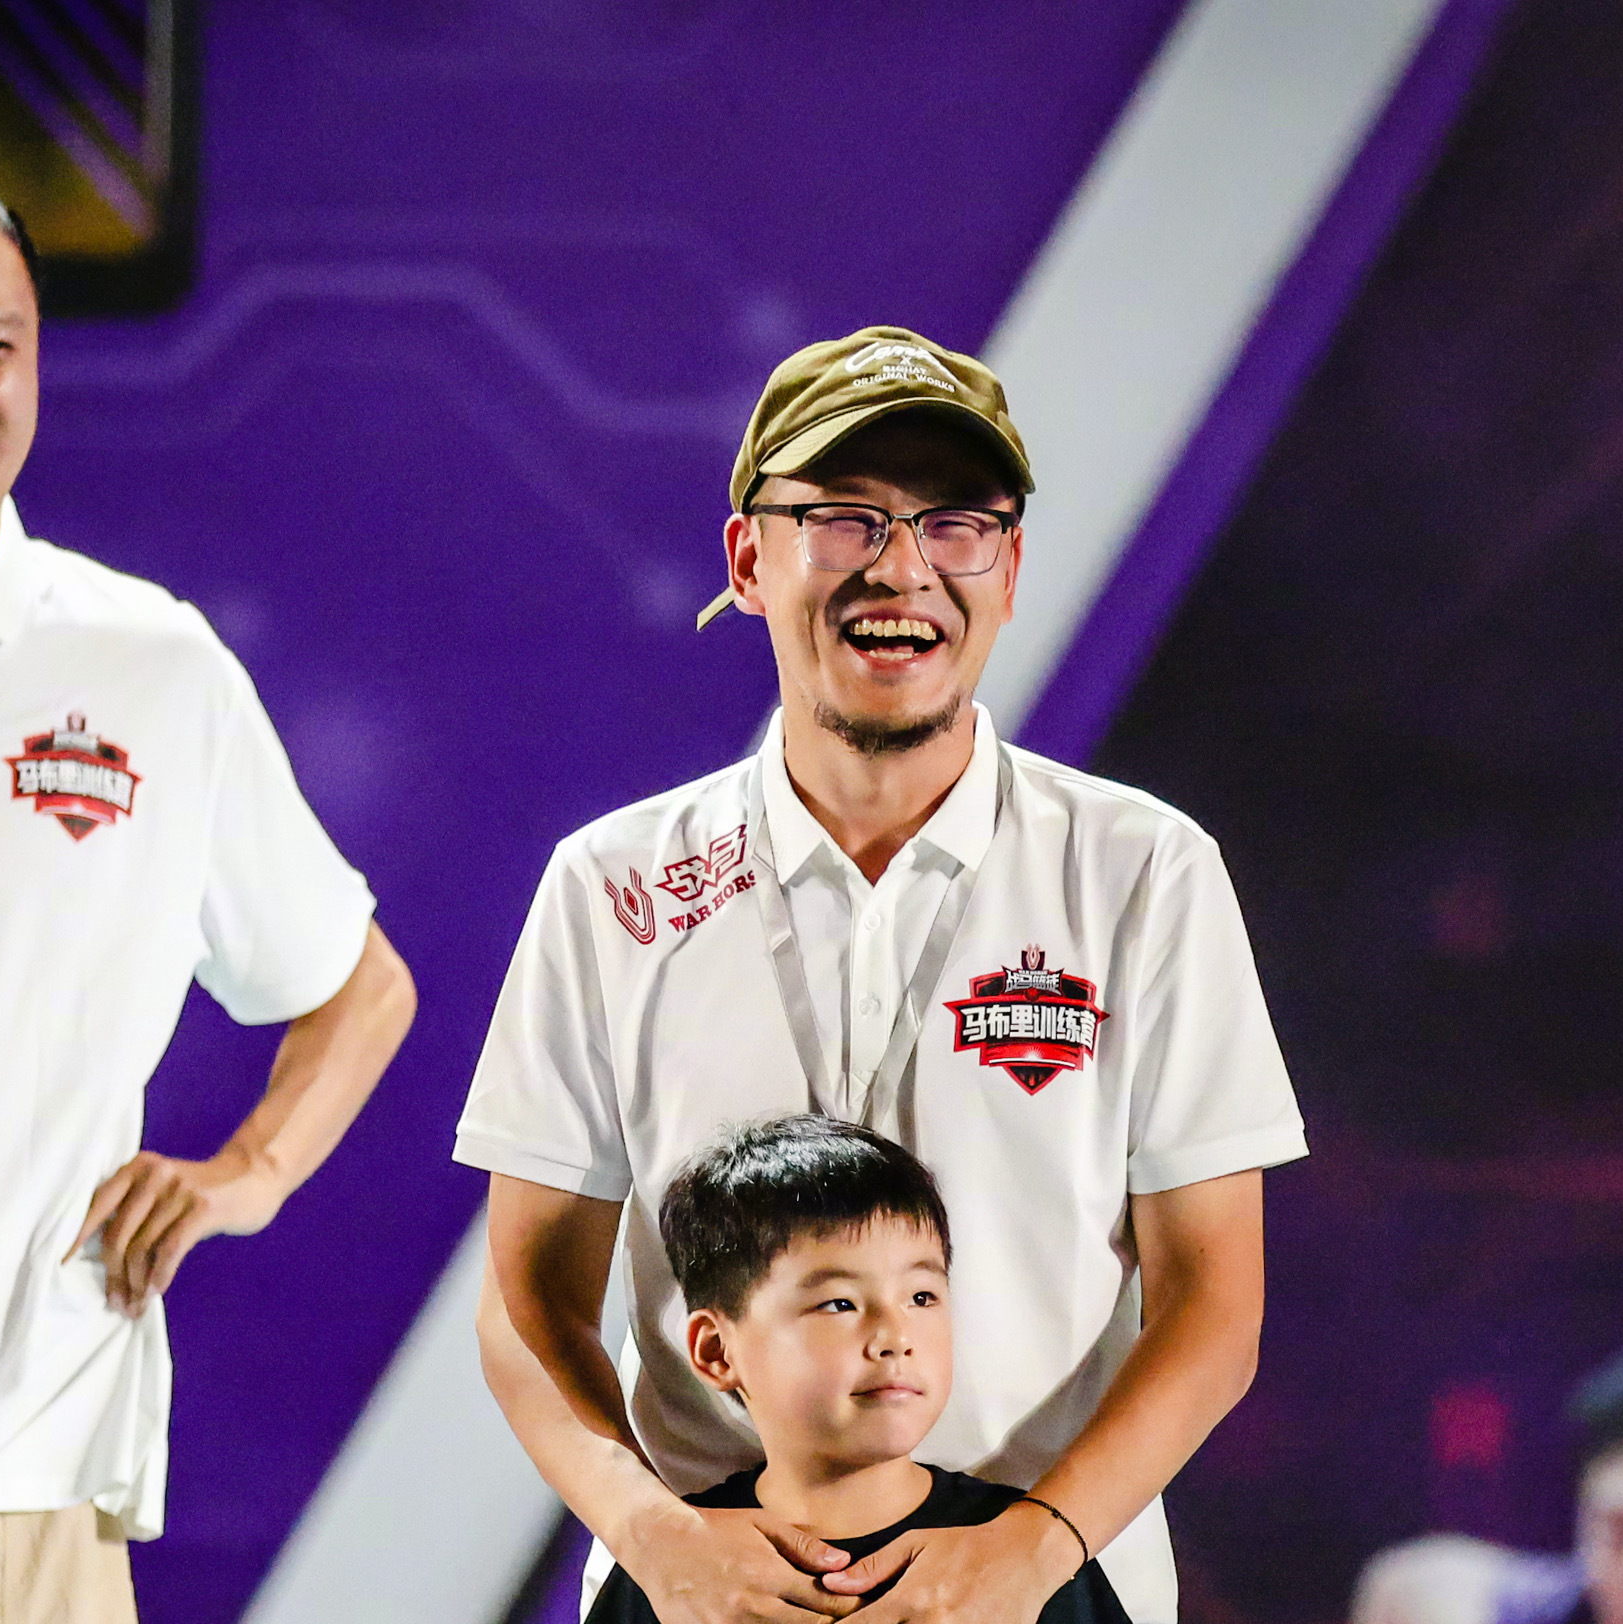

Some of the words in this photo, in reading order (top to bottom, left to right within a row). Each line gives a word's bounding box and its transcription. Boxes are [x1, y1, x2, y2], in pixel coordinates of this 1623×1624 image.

[853, 371, 910, 387] ORIGINAL
[915, 373, 955, 393] WORKS
[668, 905, 712, 932] WAR
[712, 869, 757, 911] HORS
[960, 1004, 1097, 1050] 马布里训练营
